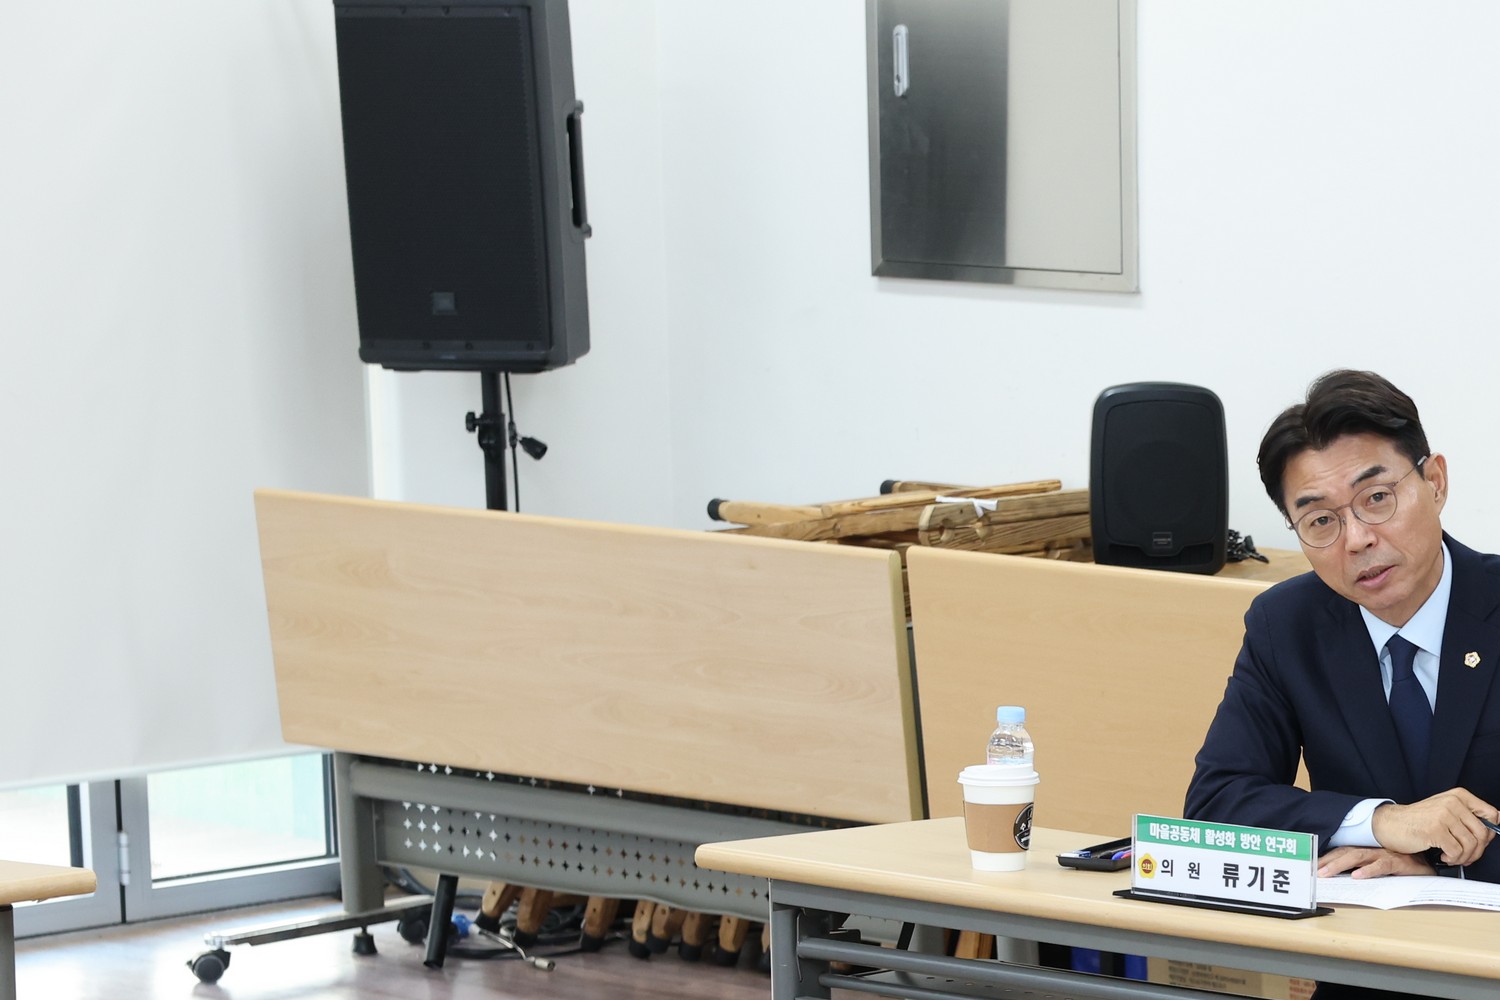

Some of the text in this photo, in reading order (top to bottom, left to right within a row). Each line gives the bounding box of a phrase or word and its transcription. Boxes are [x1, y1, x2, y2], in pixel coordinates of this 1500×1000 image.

[1149, 822, 1297, 855] 마을공동체 활성화 방안 연구회
[1222, 863, 1291, 894] 류기준
